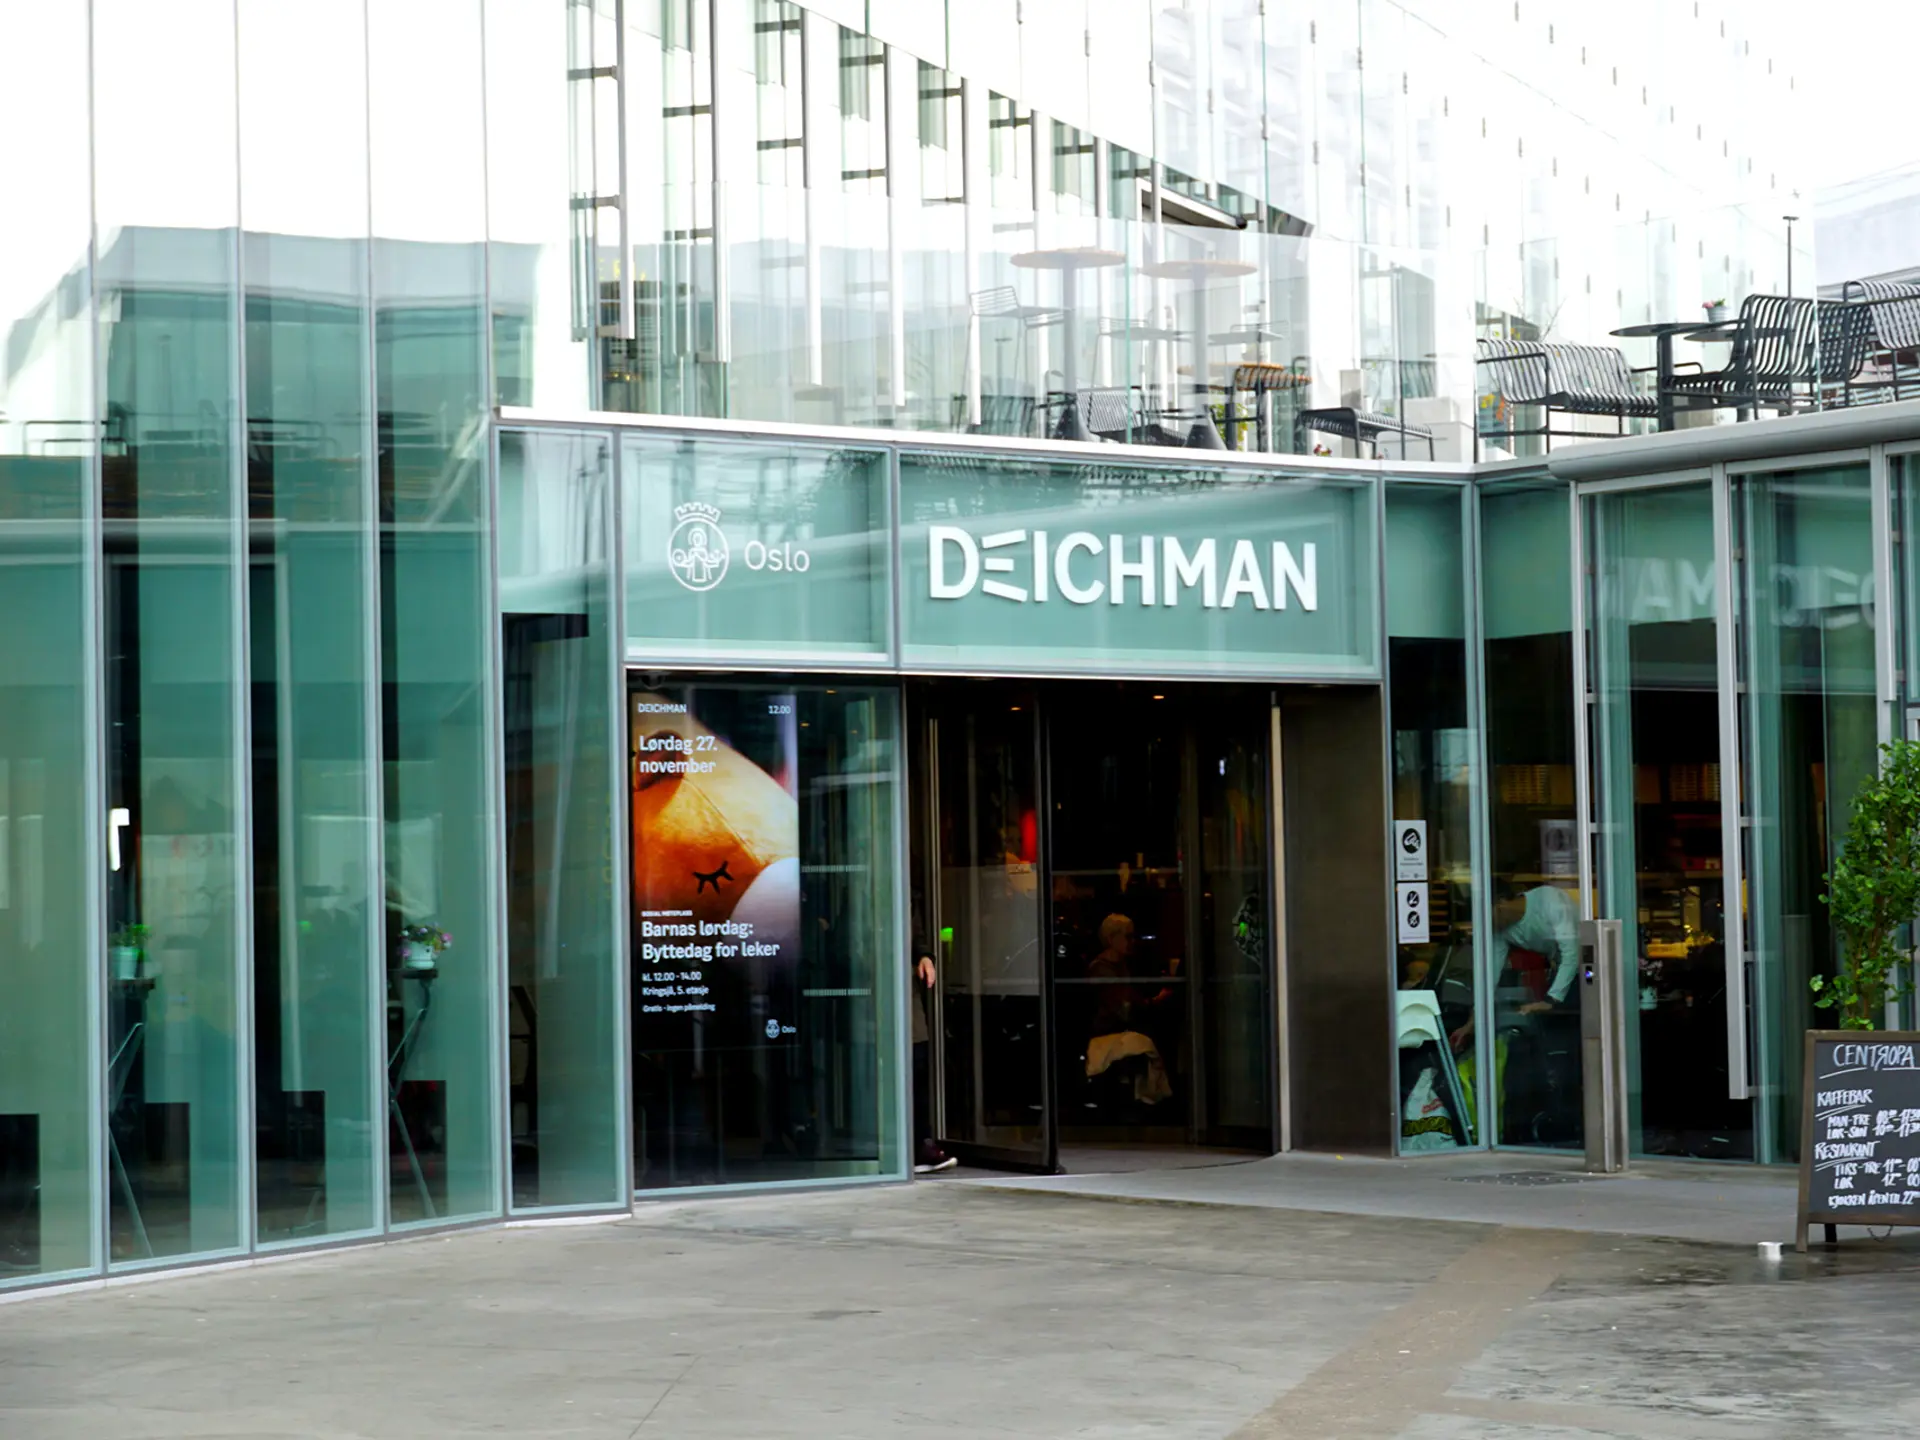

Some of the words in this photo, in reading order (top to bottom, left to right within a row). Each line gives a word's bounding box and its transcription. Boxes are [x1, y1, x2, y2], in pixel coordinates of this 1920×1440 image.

[744, 540, 810, 574] Oslo
[928, 525, 1318, 612] DEICHMAN
[638, 702, 687, 714] DEICHMAN
[768, 704, 791, 715] 12.00
[640, 735, 693, 754] Lørdag
[696, 735, 717, 752] 27.
[640, 758, 716, 774] november
[641, 921, 697, 937] Barnas
[699, 920, 754, 938] lørdag:
[642, 942, 713, 963] Byttedag
[715, 941, 739, 957] for
[741, 940, 780, 957] leker
[653, 972, 675, 982] 12.00
[680, 971, 702, 981] 14.00
[1817, 1088, 1873, 1107] KAFFEBAR
[1814, 1141, 1881, 1160] RESTAURANT
